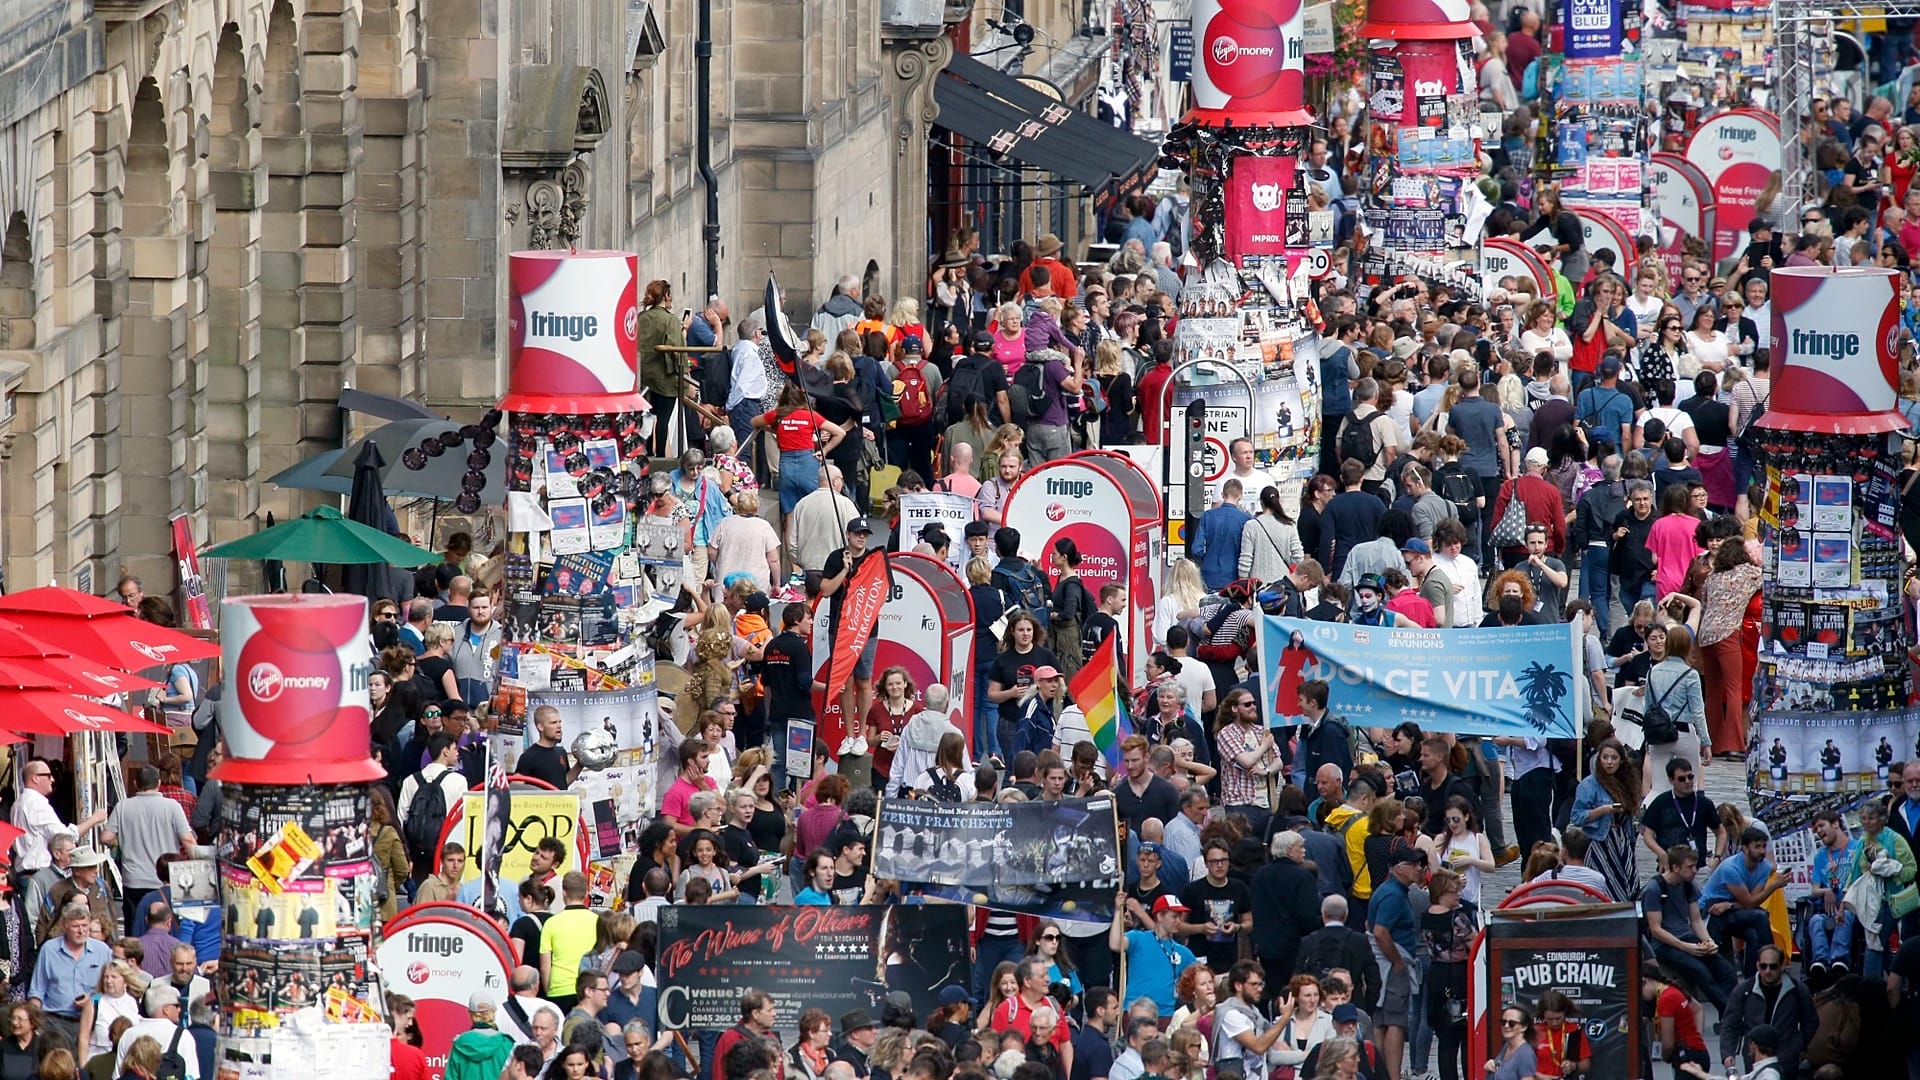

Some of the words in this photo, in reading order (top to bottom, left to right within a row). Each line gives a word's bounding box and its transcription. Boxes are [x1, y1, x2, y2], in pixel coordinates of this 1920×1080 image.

[1574, 6, 1587, 14] OF
[1591, 5, 1607, 14] THE
[1575, 16, 1608, 26] BLUE
[1240, 47, 1274, 56] money
[1719, 126, 1756, 142] fringe
[1720, 186, 1742, 194] More
[1718, 196, 1737, 204] less
[531, 311, 598, 342] fringe
[1792, 328, 1860, 360] fringe
[1178, 410, 1238, 418] PSTRIAN
[1046, 478, 1093, 498] fringe
[908, 509, 932, 518] THE
[934, 509, 964, 519] FOOL
[1067, 508, 1093, 516] money
[1081, 554, 1118, 566] Fringe,
[1074, 567, 1118, 580] queuing
[850, 577, 884, 656] ATTRACTION
[1388, 640, 1444, 649] REVUNIONS
[252, 667, 280, 696] Virgin
[284, 676, 330, 690] money
[1314, 658, 1430, 698] DOLCE
[1442, 670, 1520, 700] VITA
[971, 808, 1002, 816] Adaptation
[882, 812, 922, 826] TERRY
[925, 816, 1014, 828] PRATCHETT'S
[694, 920, 764, 960] Wives
[766, 914, 790, 953] of
[794, 906, 871, 942] Others
[408, 932, 464, 957] fringe
[1546, 952, 1586, 961] EDINBURGH
[432, 968, 462, 978] money
[1515, 963, 1552, 988] PUB
[1556, 962, 1616, 988] CRAWL
[691, 988, 734, 998] venue
[658, 985, 690, 1029] C
[785, 1000, 802, 1008] Aug
[691, 1014, 713, 1022] 0845
[714, 1014, 732, 1022] 260
[1589, 1023, 1604, 1036] £7
